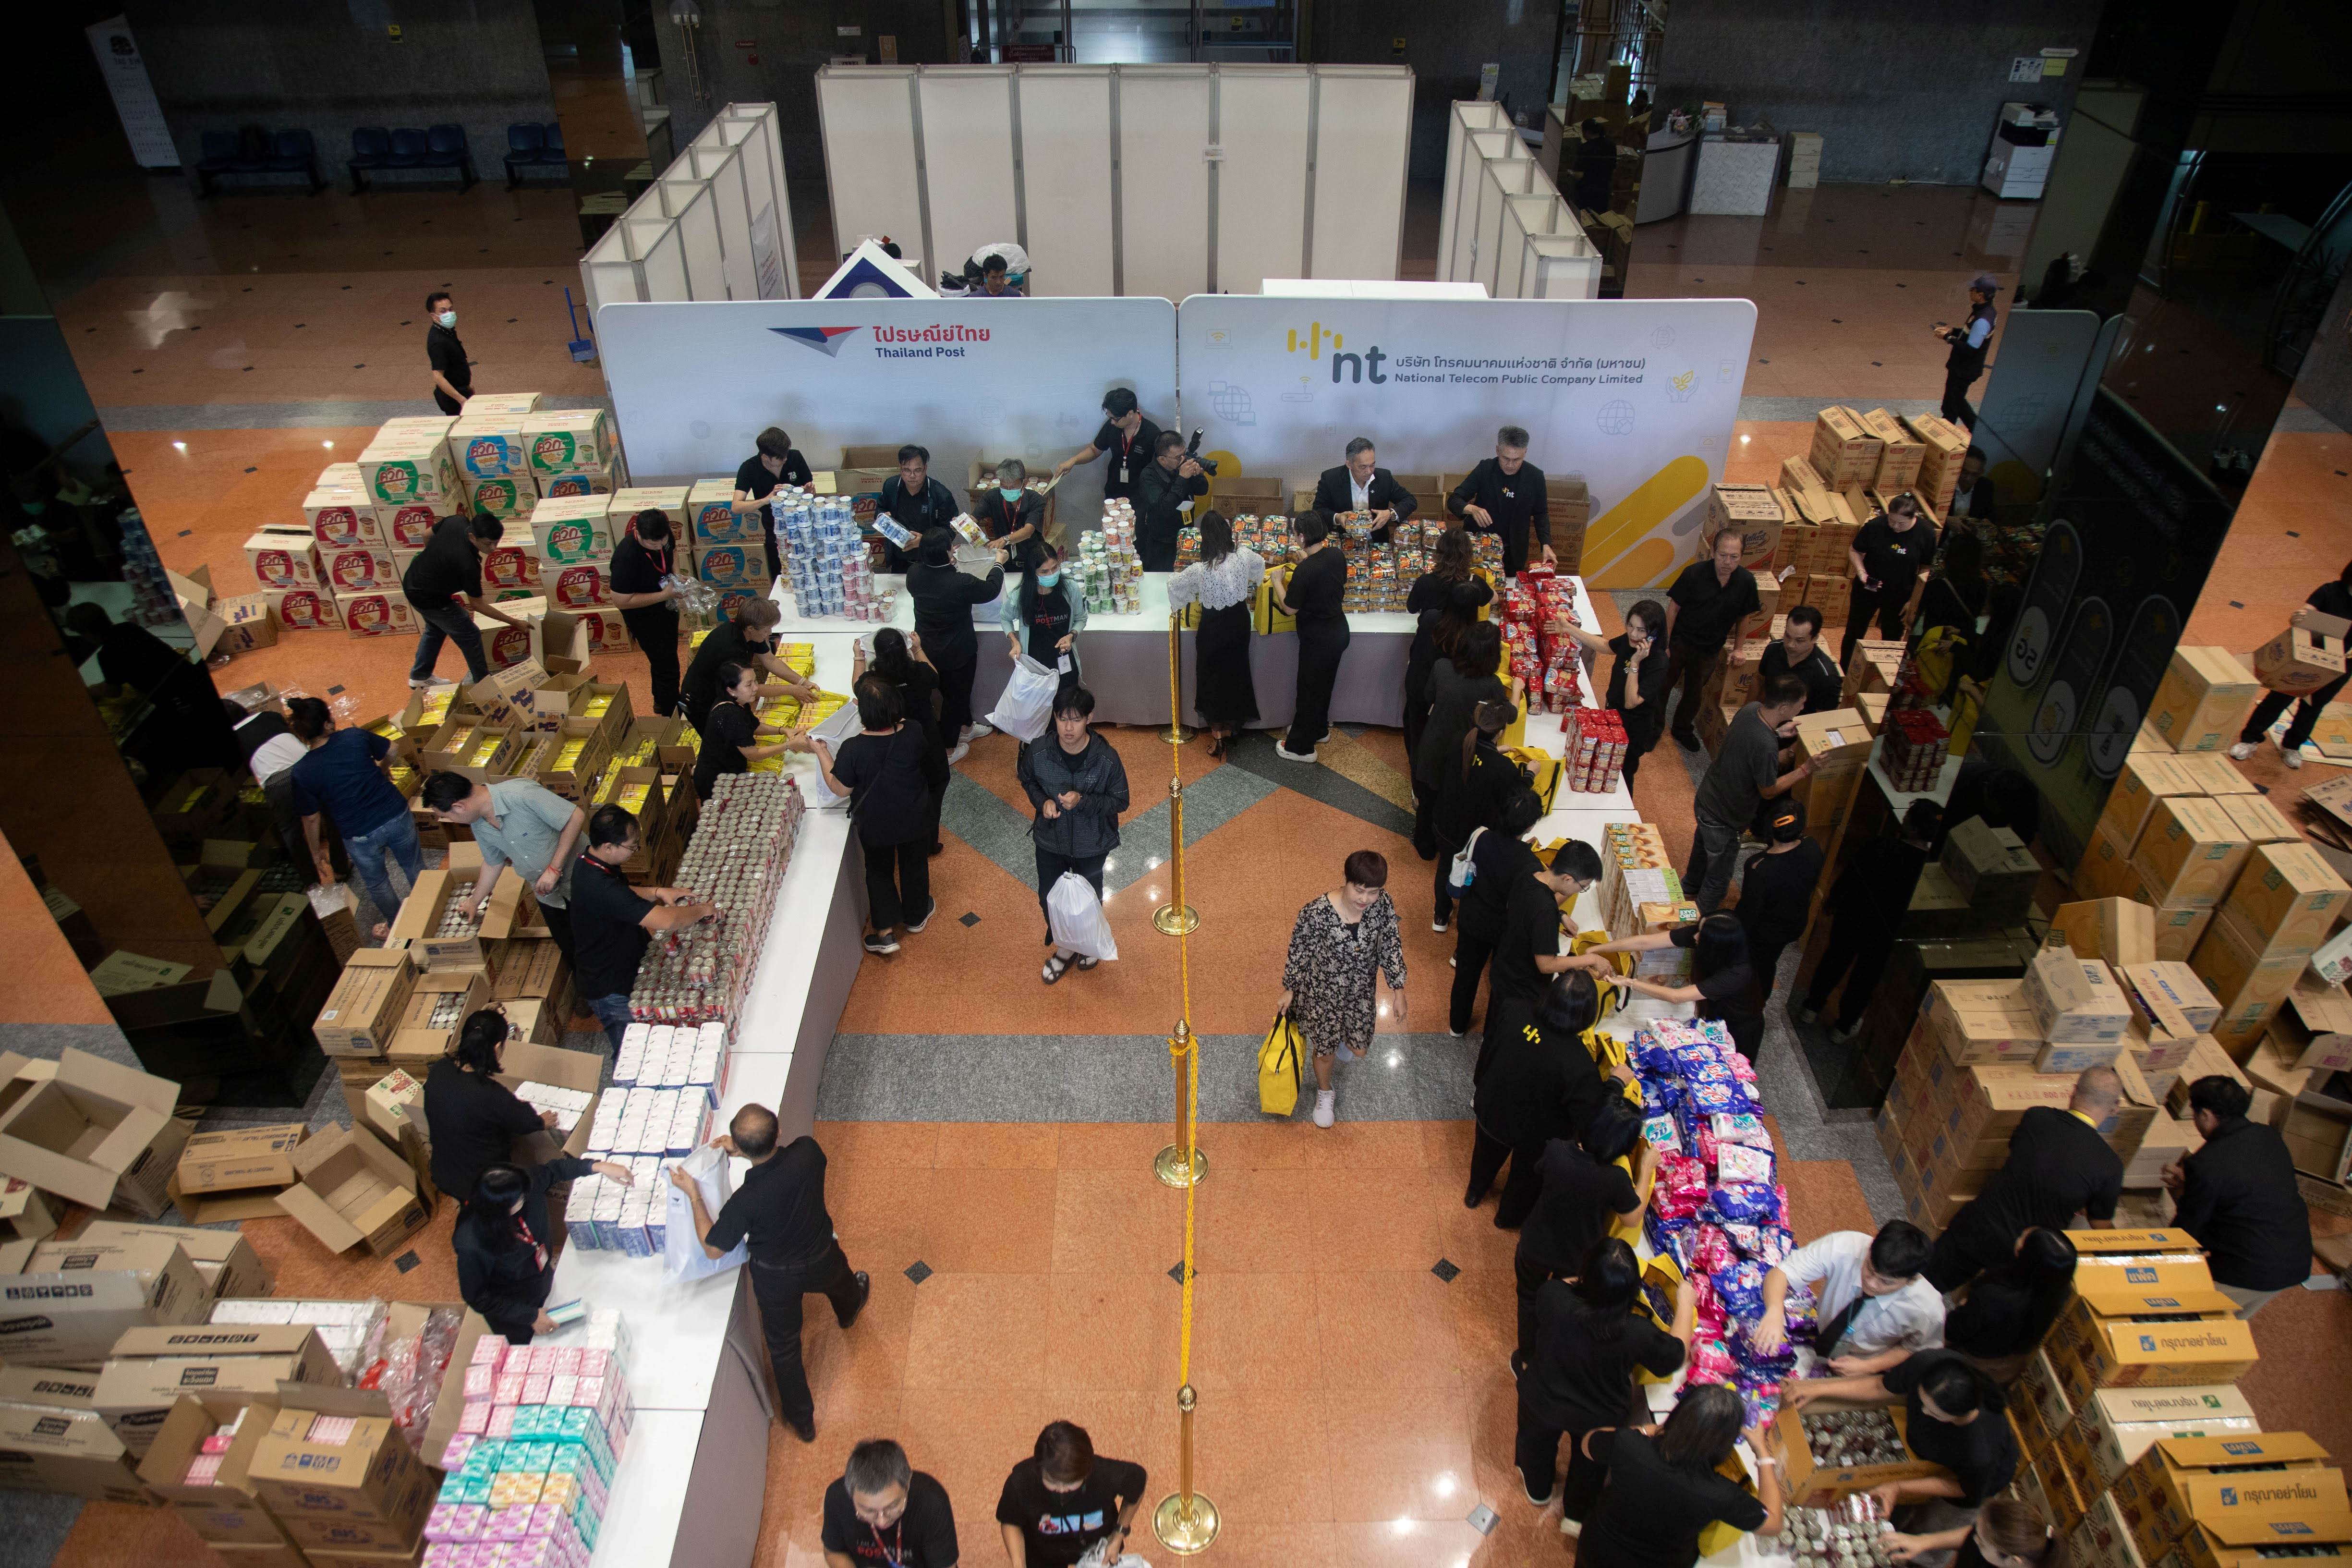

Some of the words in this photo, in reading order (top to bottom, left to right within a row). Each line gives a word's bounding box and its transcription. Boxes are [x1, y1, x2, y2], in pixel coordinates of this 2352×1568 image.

[873, 324, 990, 342] ไปรษณีย์ไทย
[875, 347, 933, 358] Thailand
[936, 347, 965, 357] Post
[1332, 345, 1387, 384] nt
[1396, 355, 1431, 368] บริษัท
[1434, 355, 1557, 369] โทรคมนาคมแห่งชาติ
[1561, 357, 1592, 369] จำกัด
[1597, 358, 1646, 370] (มหาชน)
[1395, 374, 1445, 383] National
[1449, 374, 1498, 383] Telecom
[1502, 374, 1538, 384] Public
[1541, 375, 1596, 386] Company
[1600, 374, 1643, 384] Limited
[471, 441, 495, 456] ควิก
[536, 438, 562, 452] ควิก
[379, 467, 405, 482] ควิก
[478, 486, 503, 498] ควิก
[703, 507, 728, 523] ควิก
[552, 526, 578, 542] ควิก
[706, 553, 732, 566] ควิก
[1034, 614, 1068, 624] POSTMAN
[2161, 1332, 2228, 1351] กรุณาอย่าโยน
[2131, 1395, 2198, 1412] กรุณาอย่าโยน
[2243, 1483, 2317, 1504] กรุณาอย่าโยน
